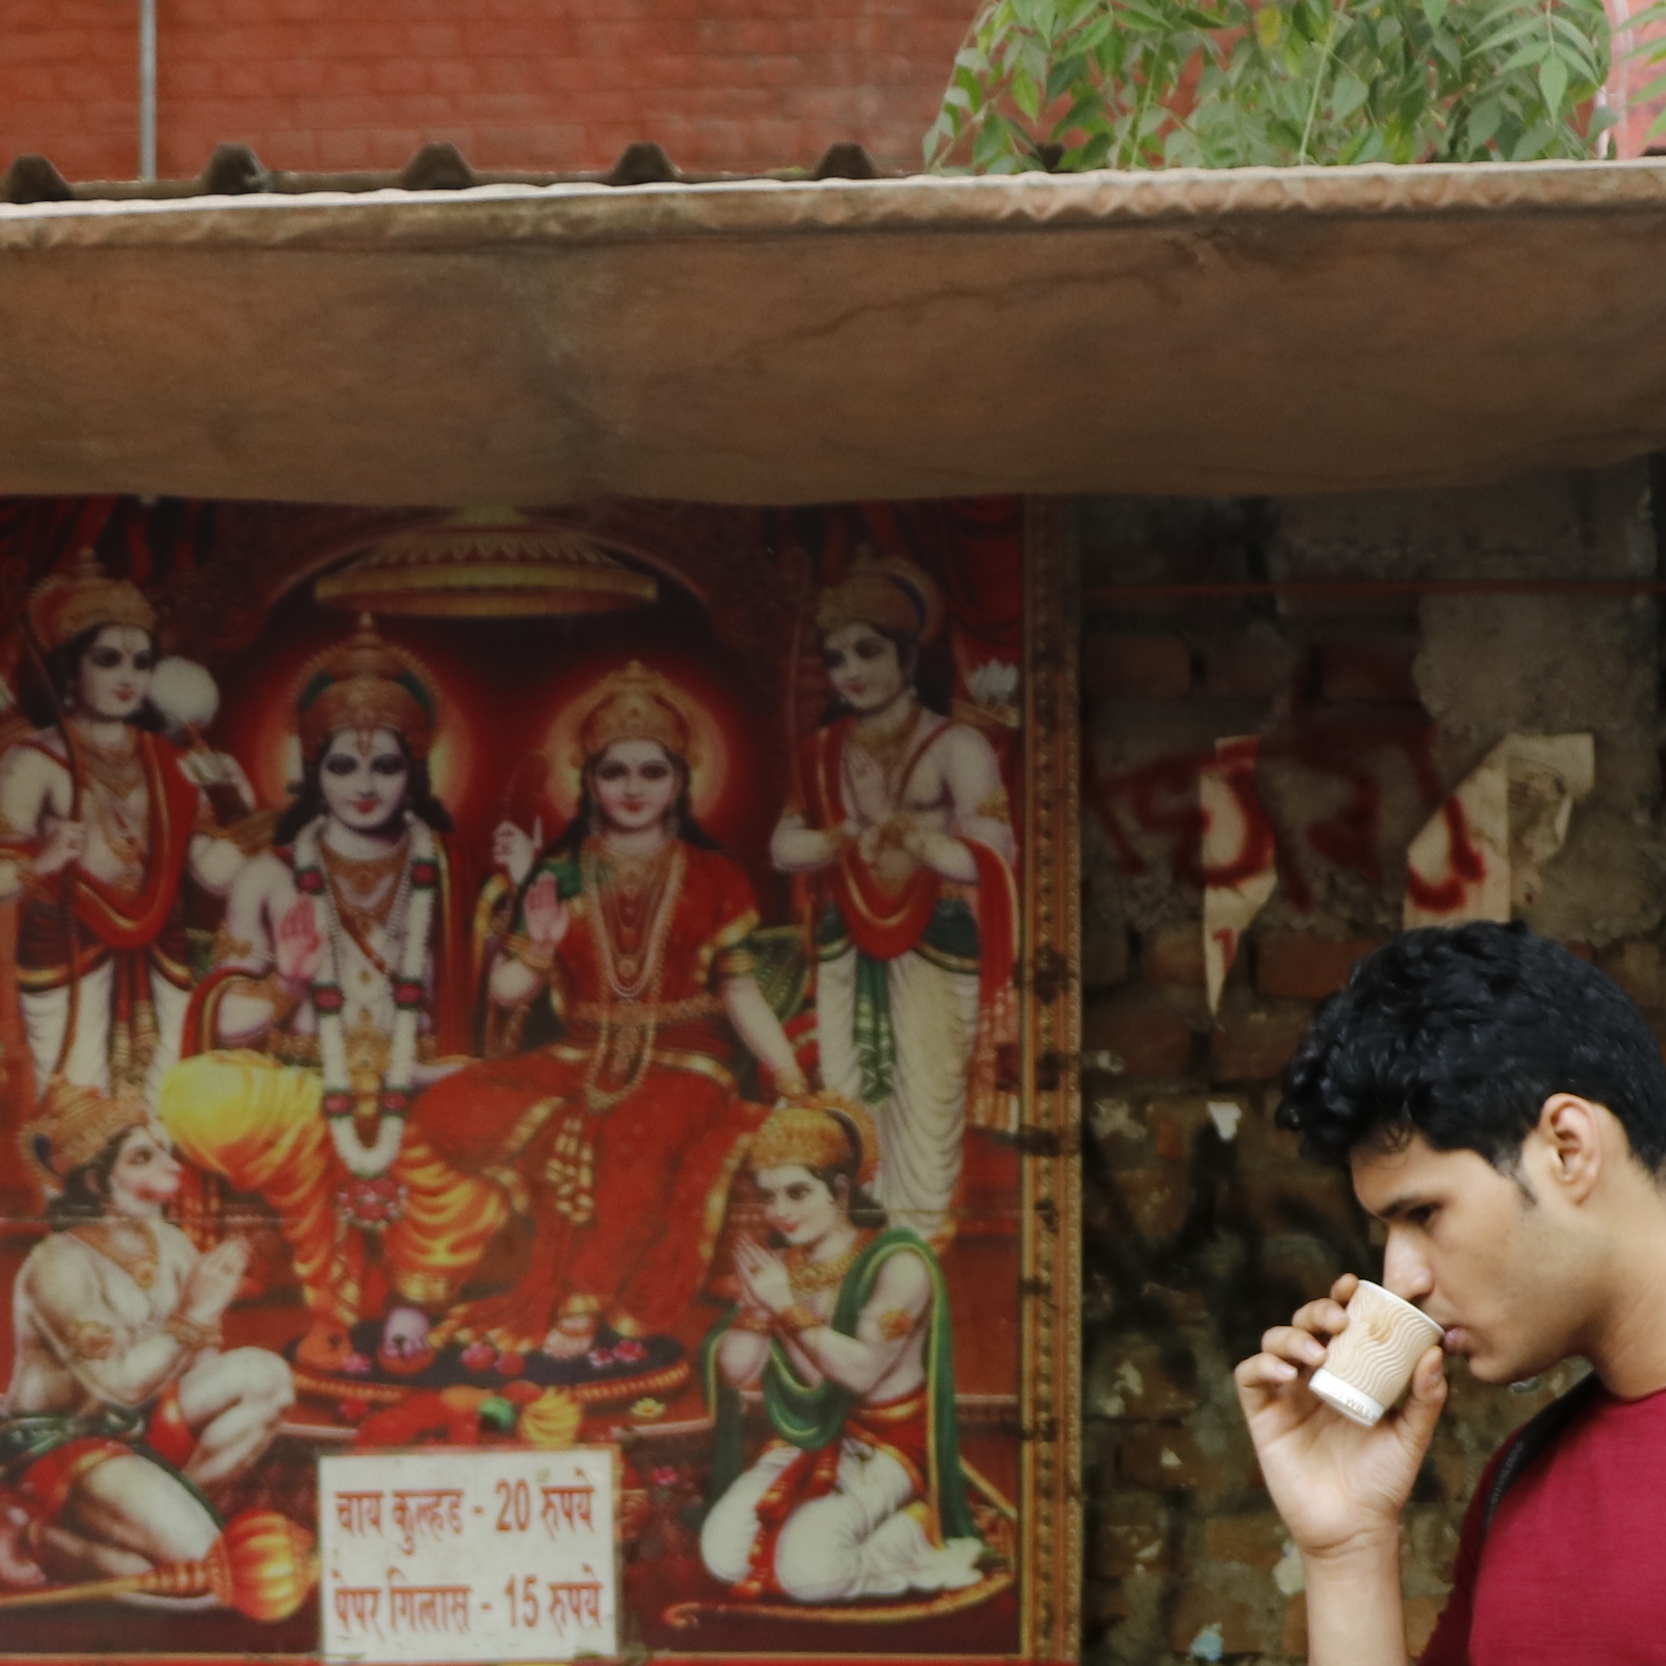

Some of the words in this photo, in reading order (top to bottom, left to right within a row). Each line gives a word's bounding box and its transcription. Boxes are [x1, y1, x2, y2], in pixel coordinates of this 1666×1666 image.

[336, 1491, 384, 1537] चाय
[495, 1478, 531, 1532] 20
[330, 1568, 386, 1643] पेपर
[386, 1565, 472, 1634] गिलास
[504, 1573, 540, 1628] 15
